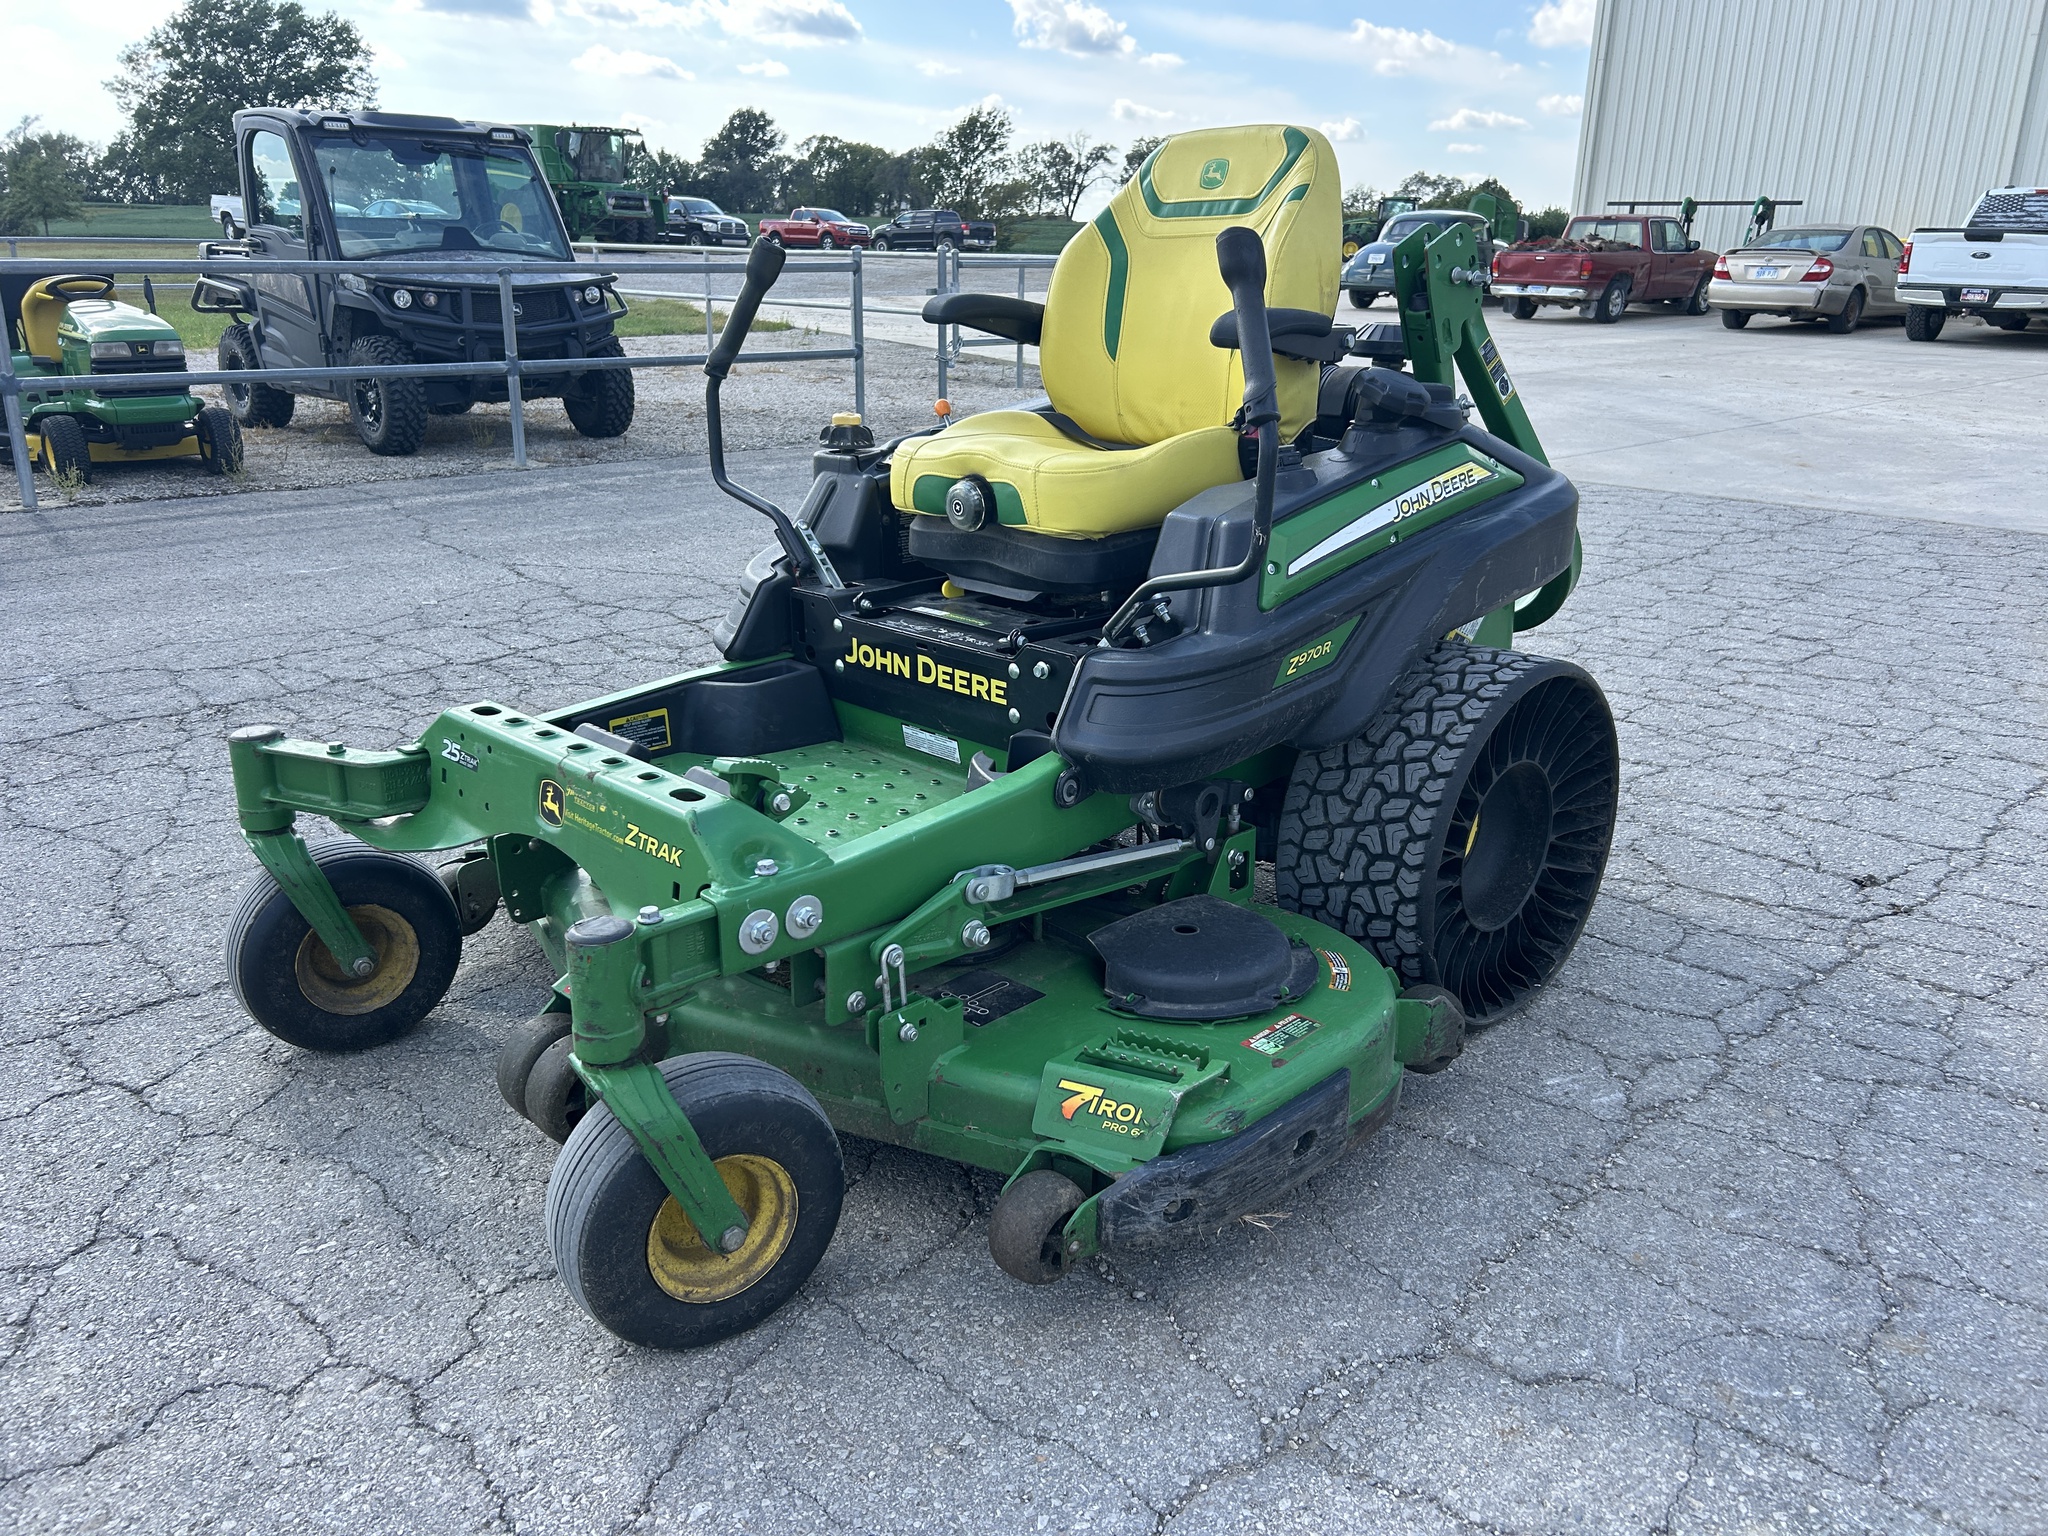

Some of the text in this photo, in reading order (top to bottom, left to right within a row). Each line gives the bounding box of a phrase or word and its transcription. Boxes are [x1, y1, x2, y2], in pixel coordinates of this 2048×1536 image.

[1393, 468, 1477, 521] JOHN DEERE
[845, 637, 910, 679] JOHN
[917, 654, 1008, 705] DEERE
[1286, 640, 1332, 676] Z970R
[441, 738, 461, 762] 25
[624, 822, 684, 868] ZTRAK
[1101, 1120, 1128, 1135] PRO
